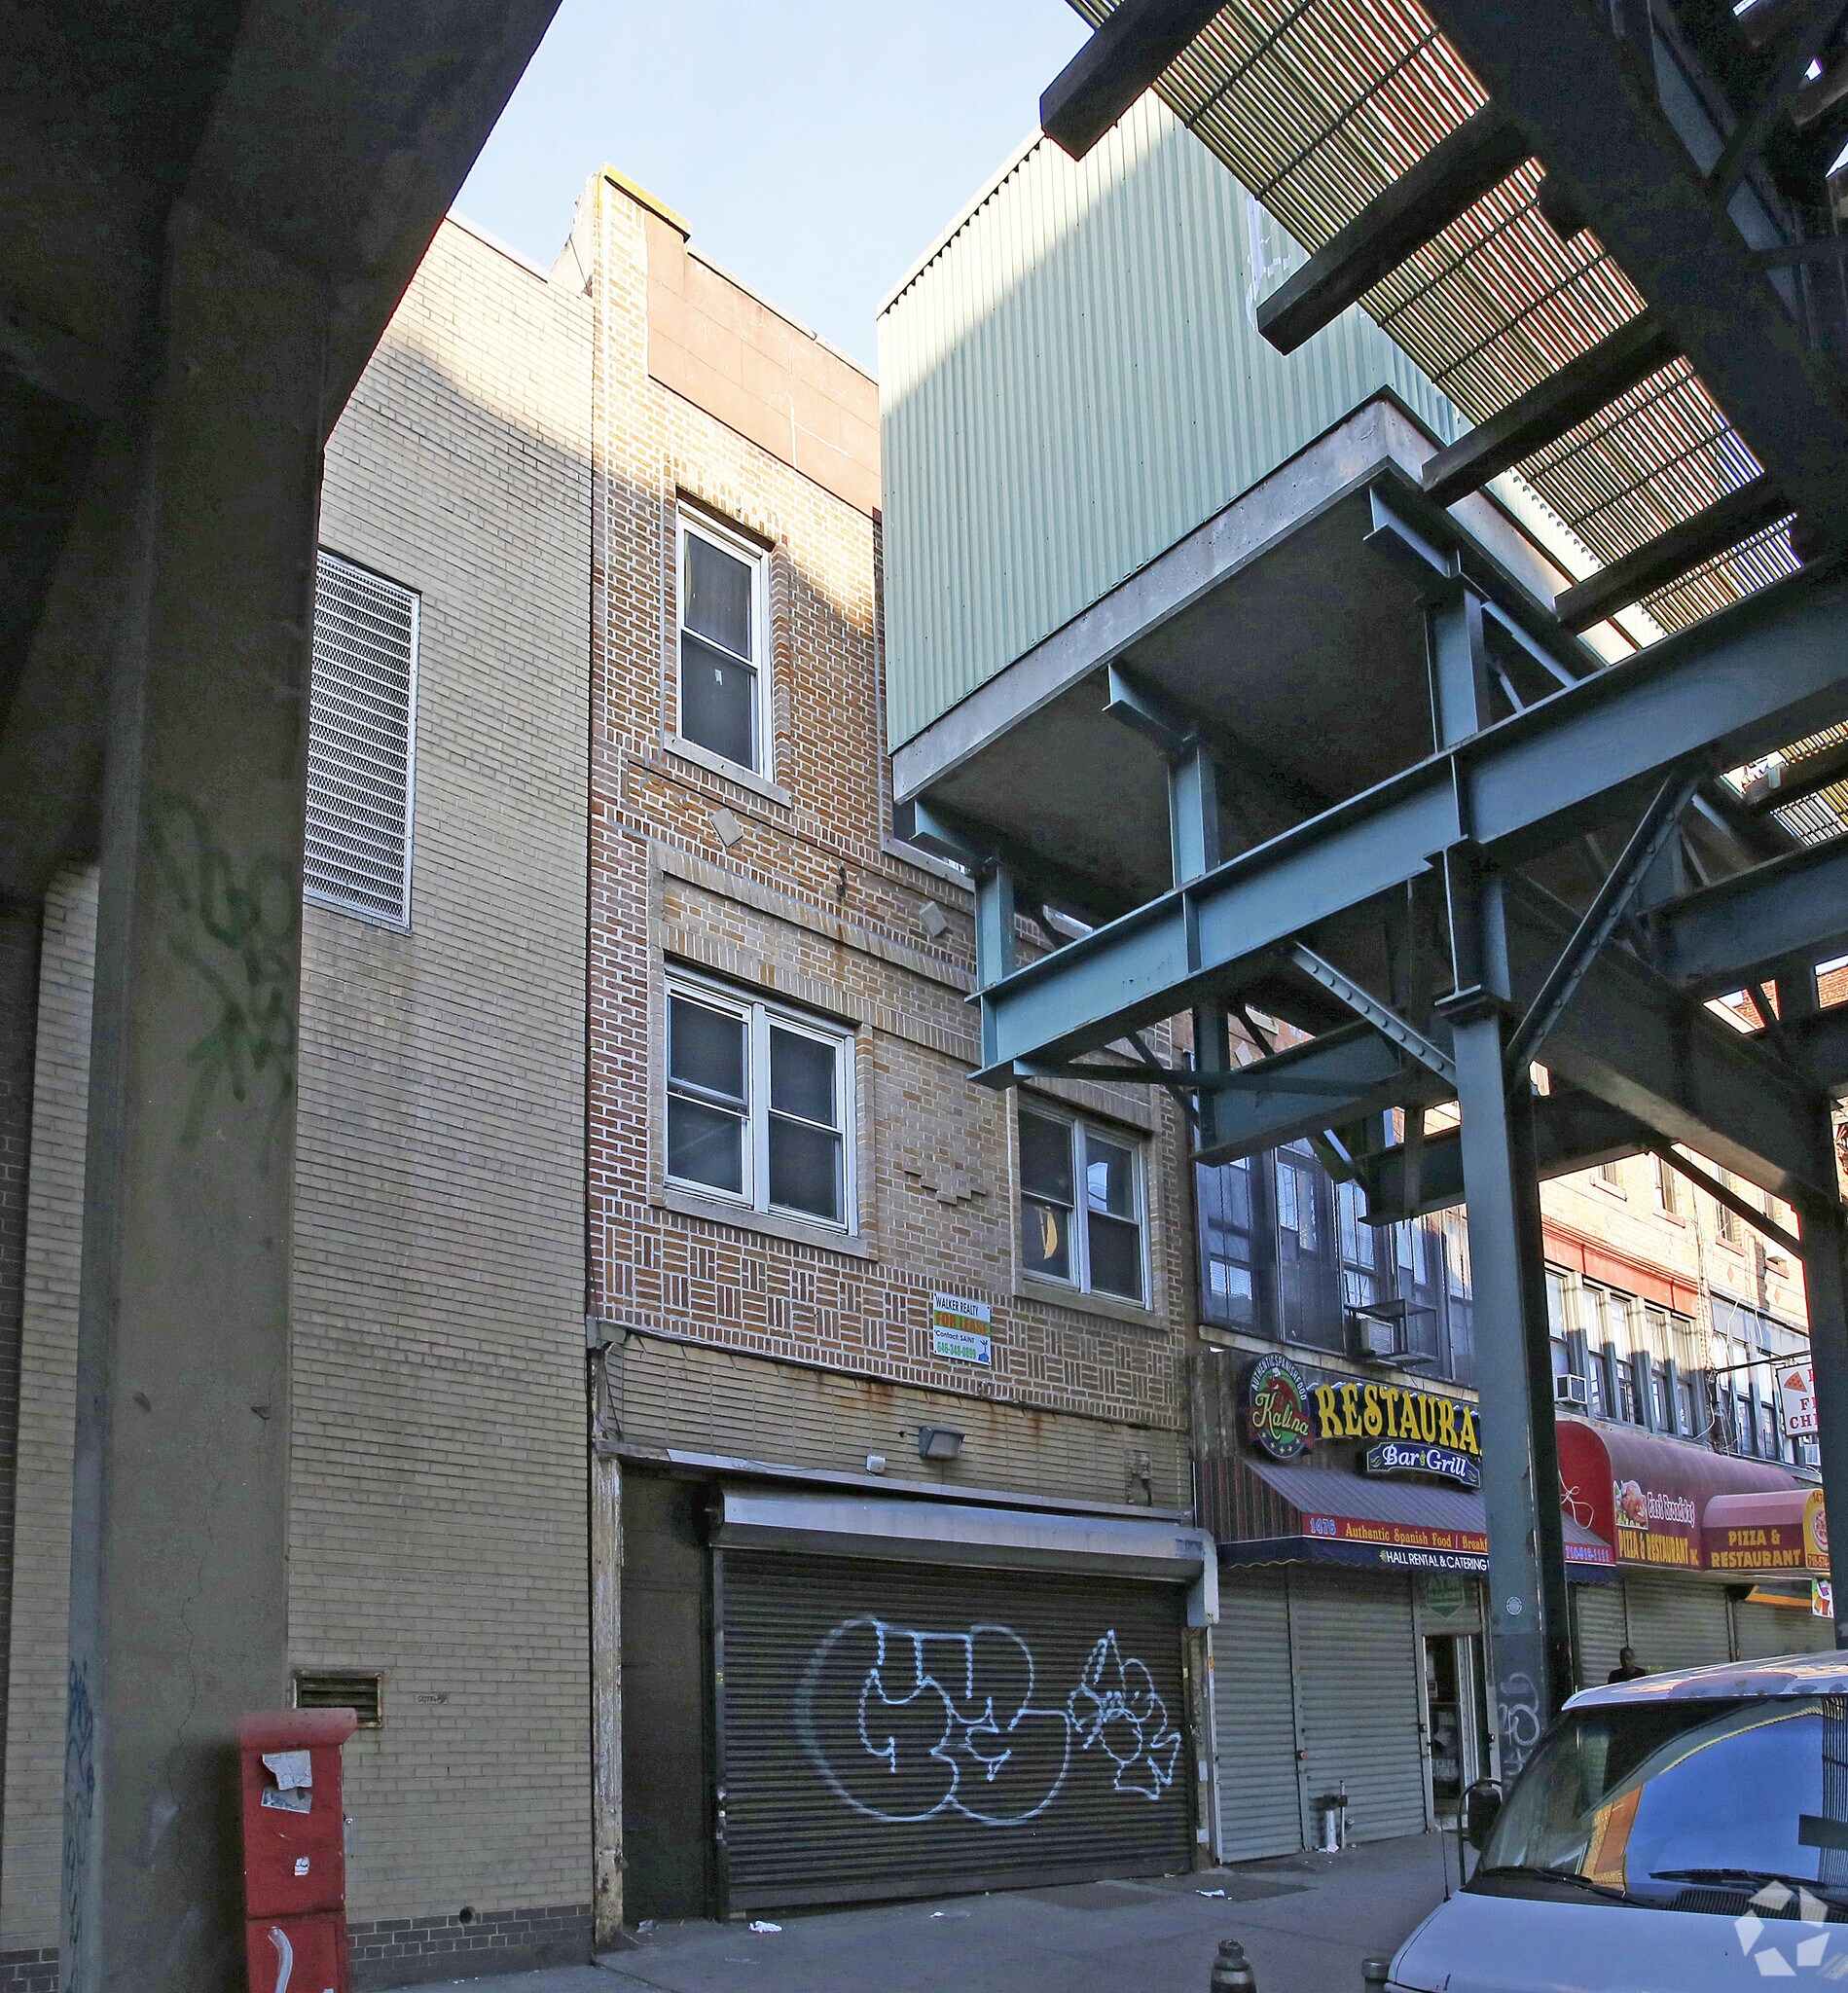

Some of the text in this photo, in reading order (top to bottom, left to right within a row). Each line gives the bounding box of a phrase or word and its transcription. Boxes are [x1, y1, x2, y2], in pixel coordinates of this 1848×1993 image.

[936, 1296, 979, 1317] WALKER REALTY
[936, 1311, 988, 1336] FOR LEASE
[1251, 1356, 1307, 1400] AUTHENTIC SPANISH FOOD
[1252, 1392, 1309, 1439] Kalina
[1315, 1382, 1483, 1456] RESTAURA
[1382, 1444, 1467, 1477] Bar Grill
[1310, 1517, 1489, 1552] 1476 Authentic Spanish Food Breakf
[1617, 1529, 1640, 1559] PIZZA
[1640, 1532, 1646, 1560] &
[1646, 1533, 1688, 1565] RESTAURANT
[1727, 1529, 1781, 1546] PIZZA &
[1386, 1550, 1409, 1565] HALL
[1408, 1553, 1439, 1567] RENTAL
[1439, 1555, 1447, 1568] &
[1446, 1556, 1487, 1572] CATERING
[1711, 1548, 1801, 1568] RESTAURANT
